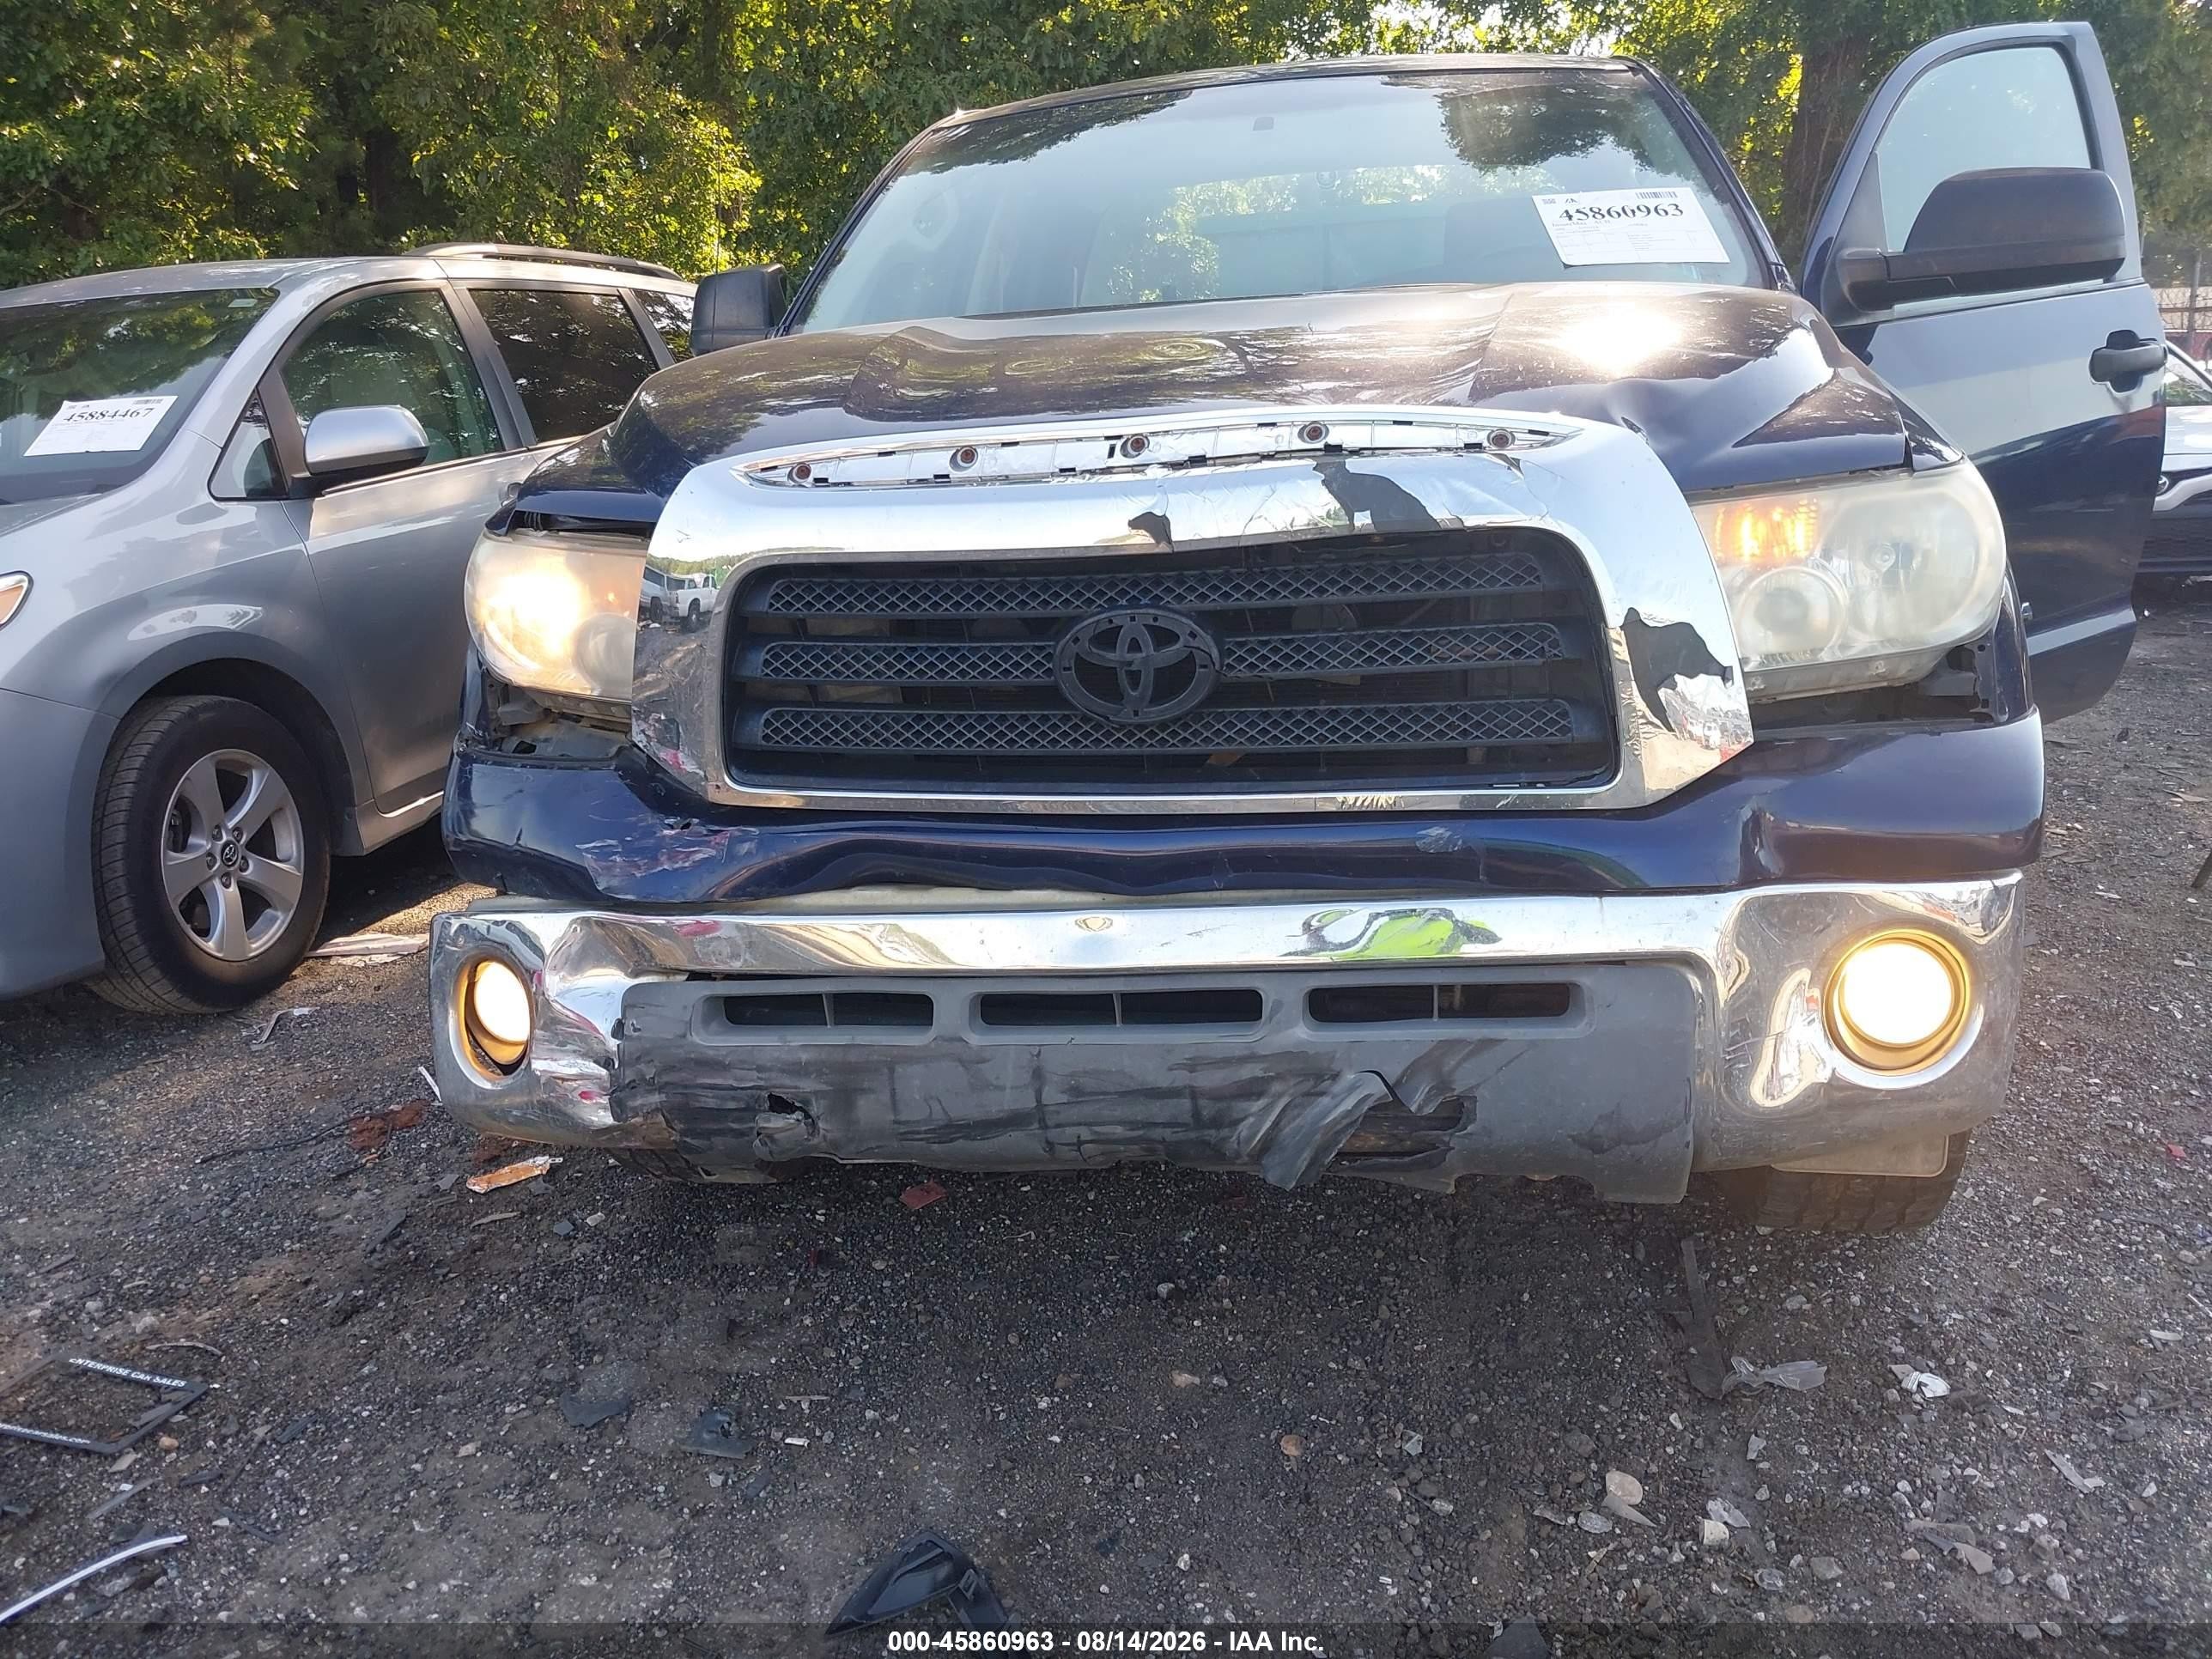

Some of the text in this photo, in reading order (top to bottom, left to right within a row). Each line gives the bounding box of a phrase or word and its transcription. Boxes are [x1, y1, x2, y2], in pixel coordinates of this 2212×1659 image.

[1559, 203, 1684, 222] 45860963
[64, 407, 155, 422] 45884467
[69, 1358, 187, 1387] ENTERPRISE CAR SALES
